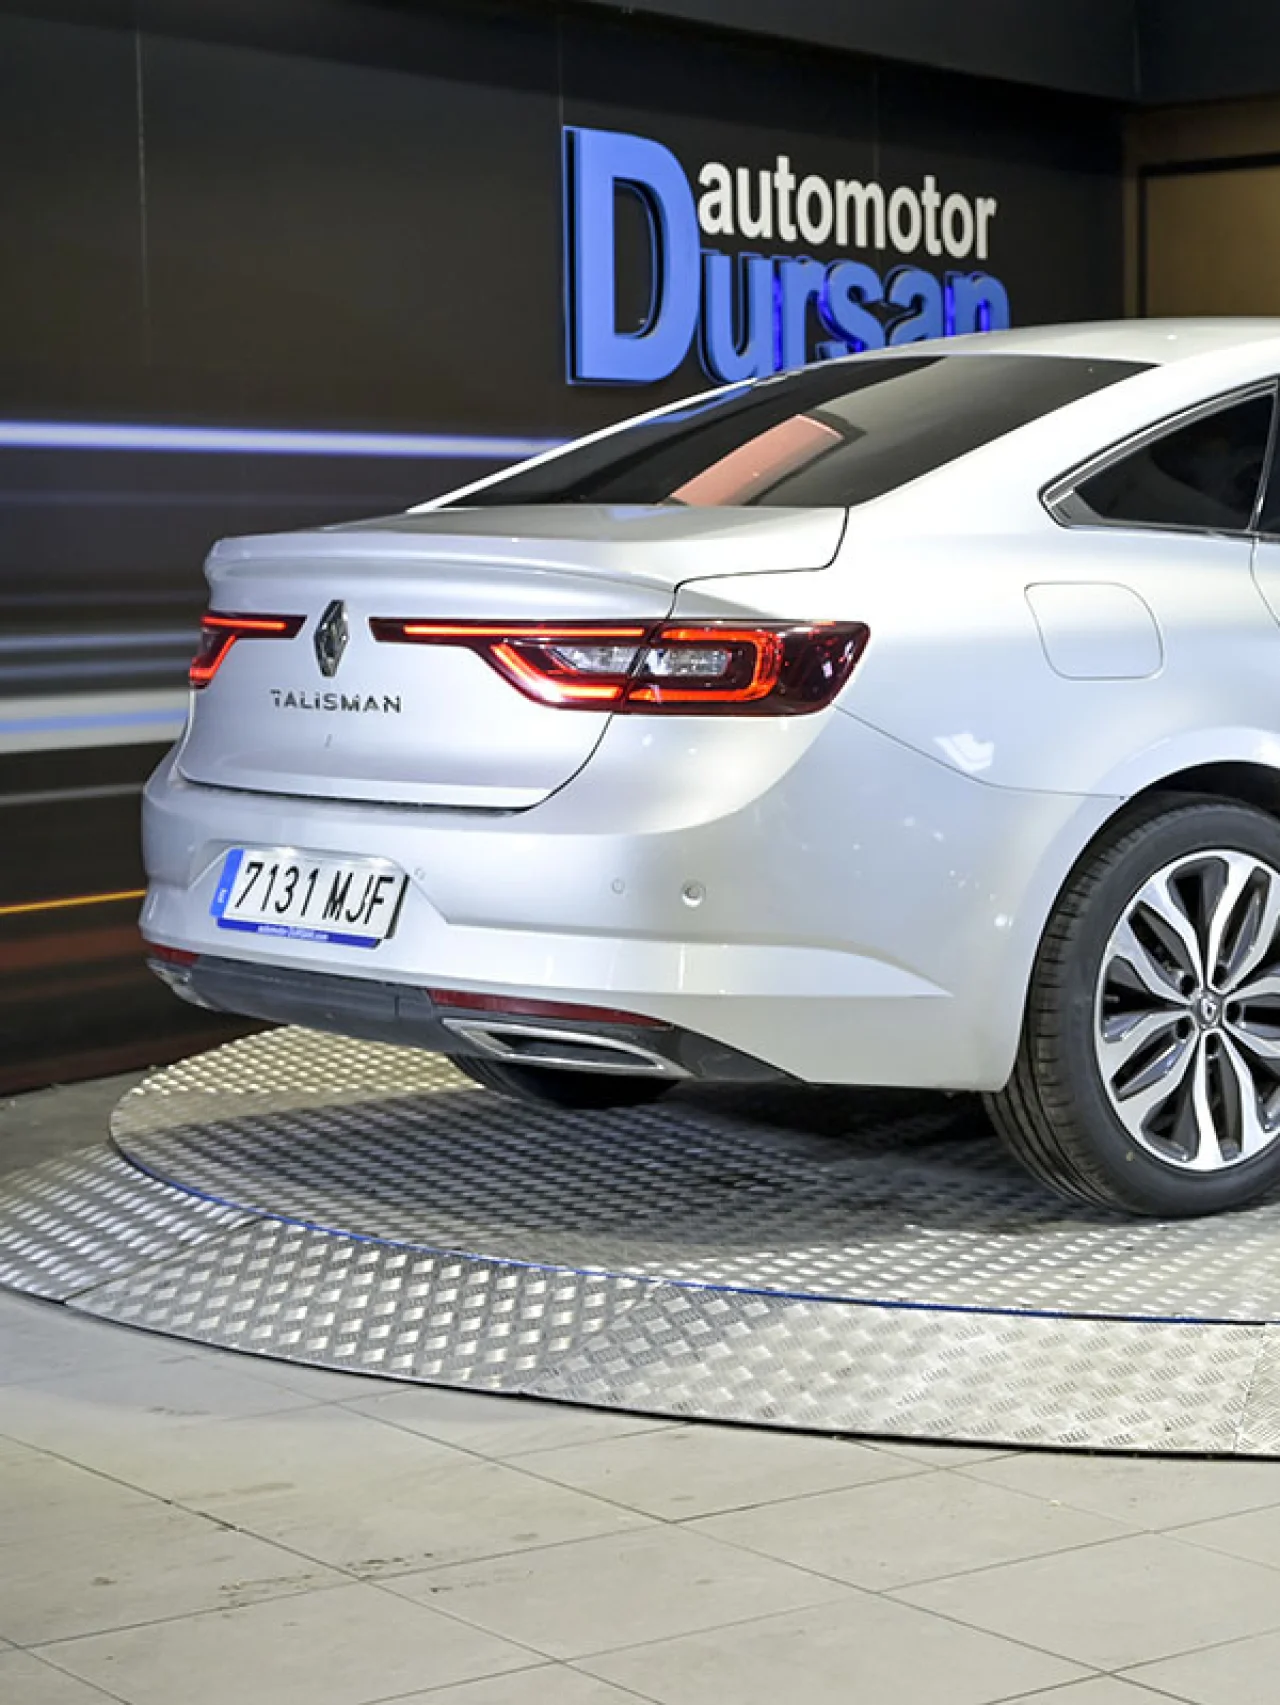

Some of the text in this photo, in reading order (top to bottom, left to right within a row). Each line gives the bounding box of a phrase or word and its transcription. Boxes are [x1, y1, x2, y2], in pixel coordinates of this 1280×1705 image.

[563, 125, 1010, 386] Dursan
[698, 155, 997, 260] automotor
[235, 861, 394, 925] 7131 MJF
